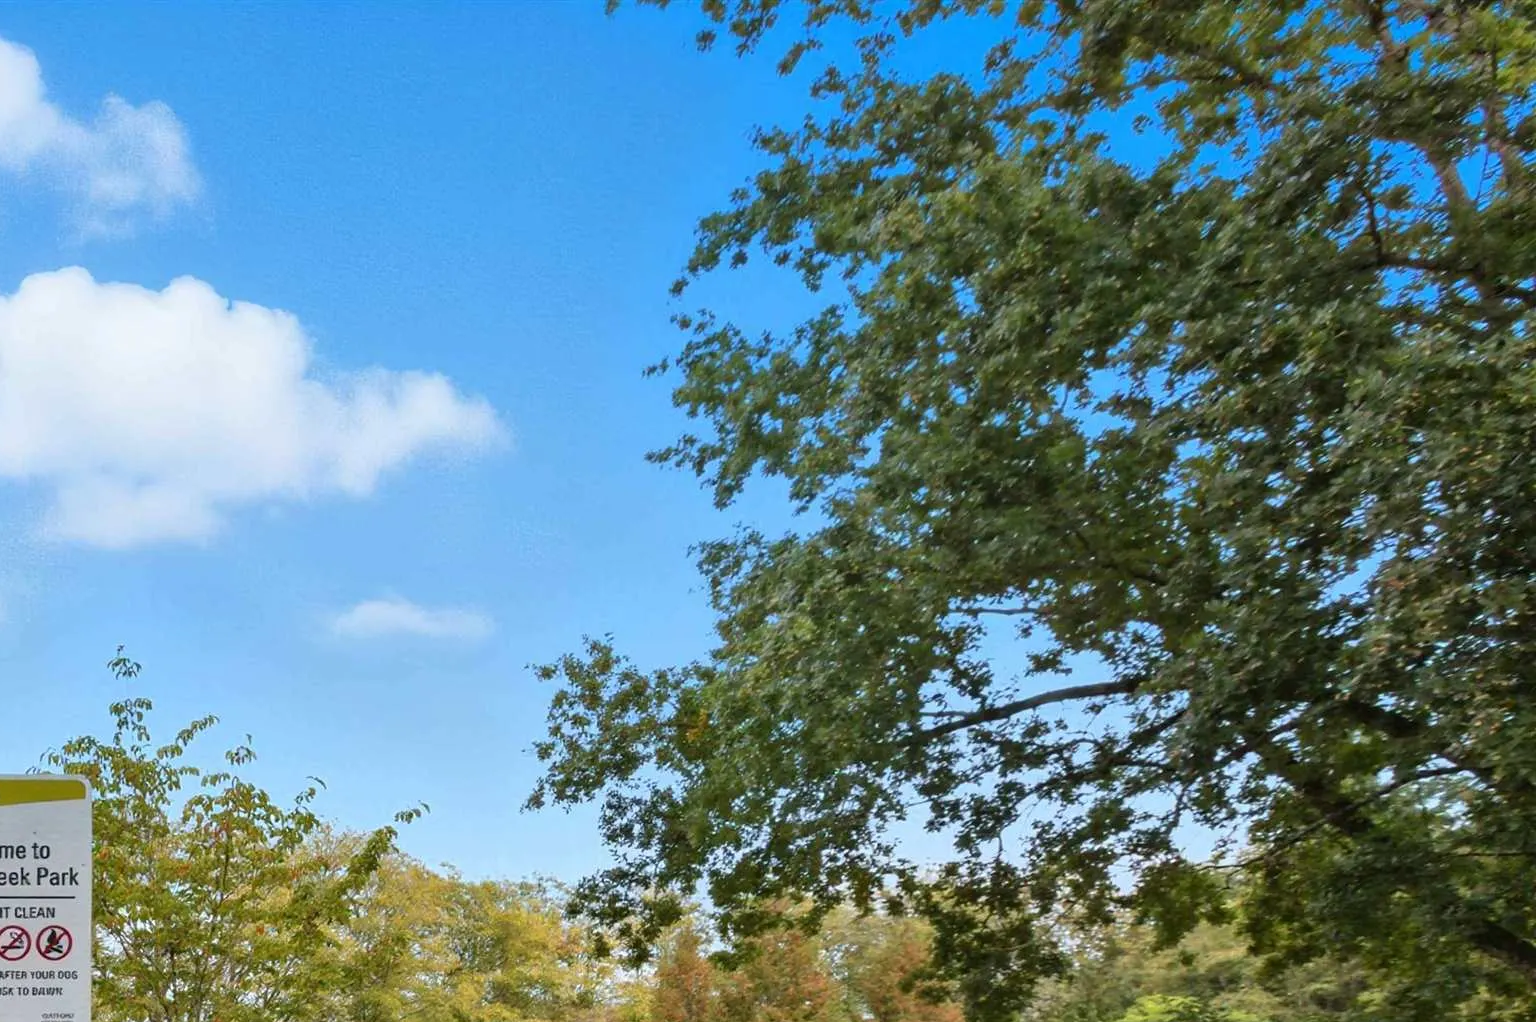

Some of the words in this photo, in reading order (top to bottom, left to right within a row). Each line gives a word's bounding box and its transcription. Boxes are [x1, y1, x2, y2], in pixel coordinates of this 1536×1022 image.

[31, 842, 51, 860] to
[36, 867, 79, 886] Park
[0, 906, 11, 919] IT
[14, 906, 56, 919] CLEAN
[30, 970, 56, 980] YOUR
[57, 970, 79, 980] DOG
[16, 986, 30, 996] TO
[31, 986, 64, 996] DAWN
